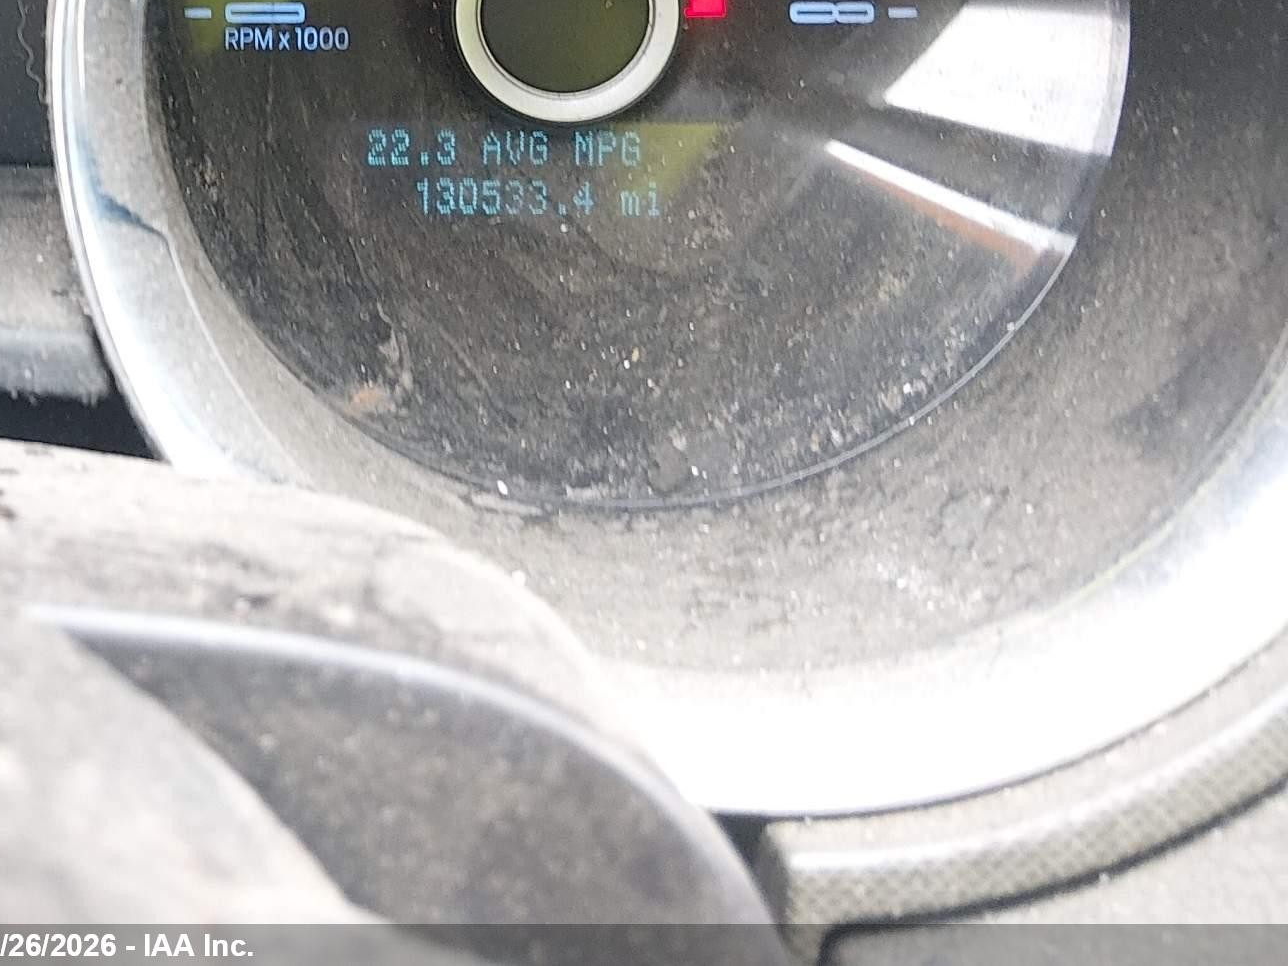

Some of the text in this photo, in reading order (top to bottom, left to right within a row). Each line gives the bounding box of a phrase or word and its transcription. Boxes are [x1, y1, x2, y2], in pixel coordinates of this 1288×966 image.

[789, 1, 874, 23] 8
[367, 128, 642, 168] 22.3 AVG MPG
[620, 180, 661, 216] mi
